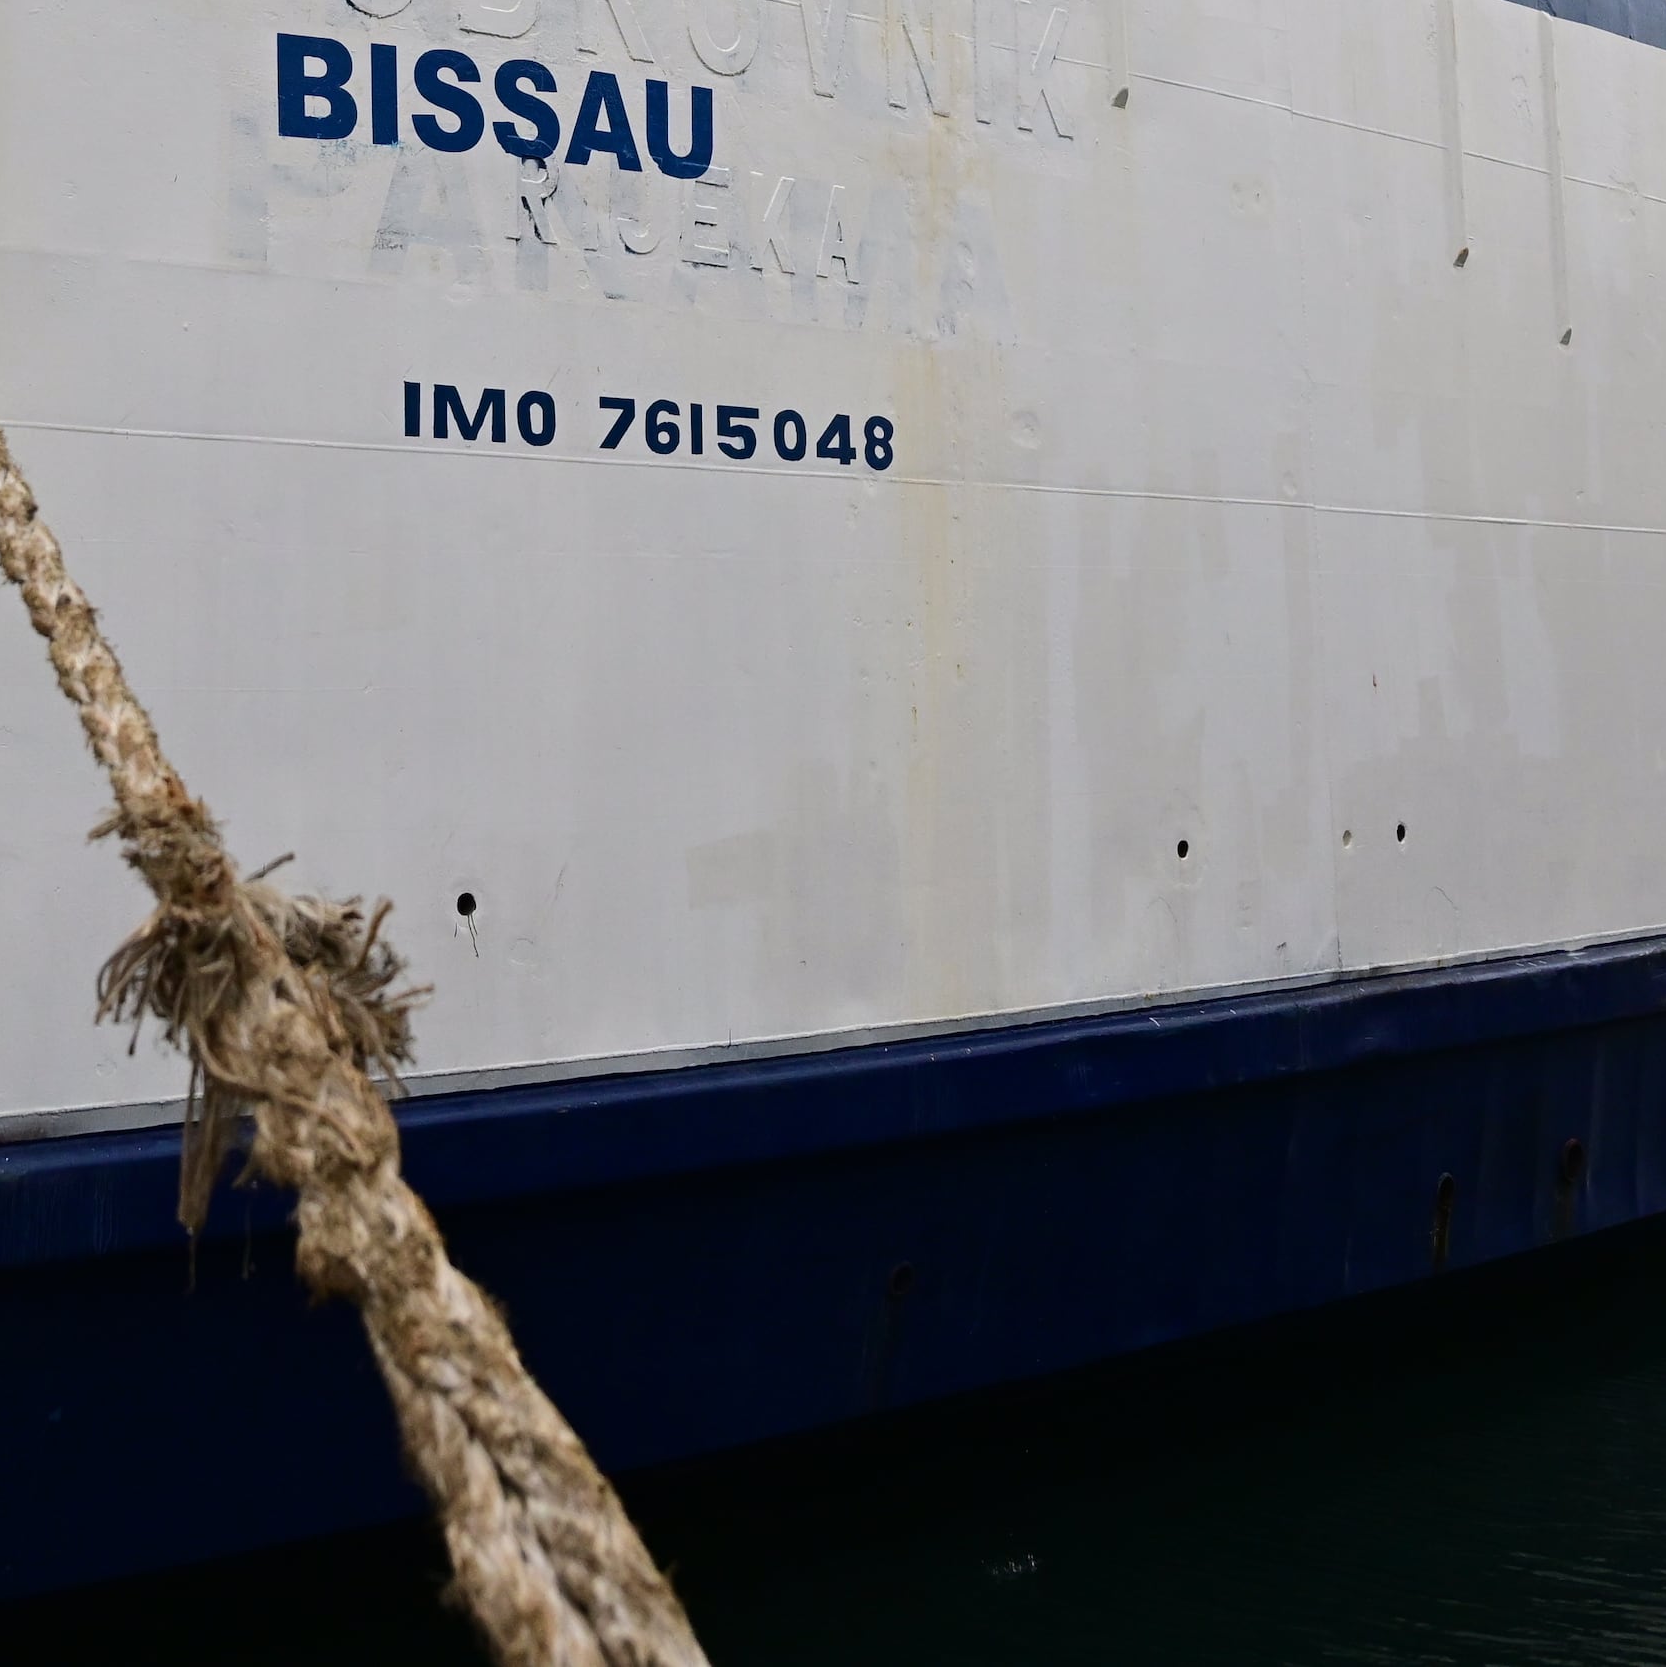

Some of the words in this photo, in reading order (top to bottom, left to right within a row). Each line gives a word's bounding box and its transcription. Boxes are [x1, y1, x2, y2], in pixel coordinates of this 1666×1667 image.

[276, 33, 714, 180] BISSAU
[404, 381, 556, 447] IMO
[599, 396, 894, 471] 7615048
